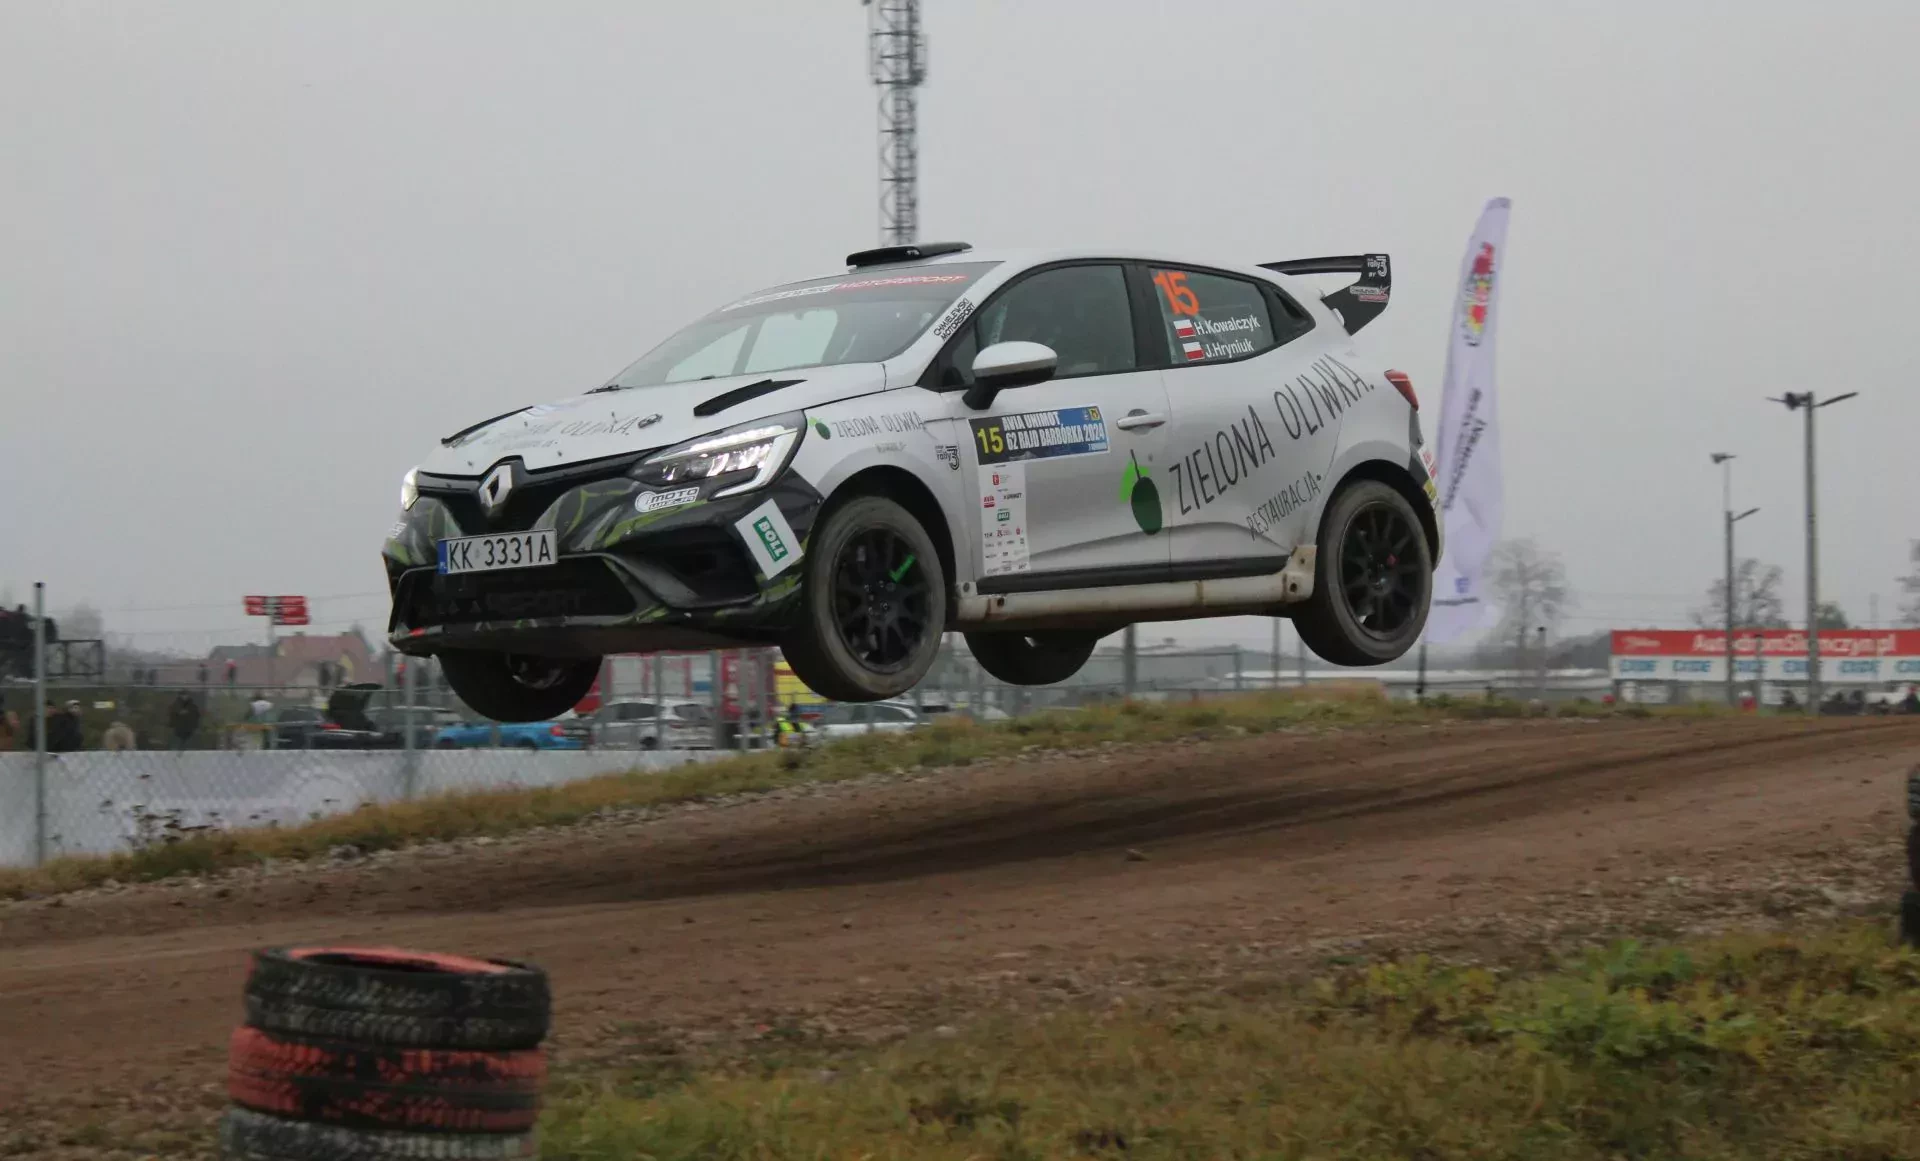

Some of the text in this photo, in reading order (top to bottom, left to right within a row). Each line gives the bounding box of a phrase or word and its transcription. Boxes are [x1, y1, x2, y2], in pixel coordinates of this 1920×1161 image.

[1153, 271, 1199, 316] 15
[933, 298, 969, 337] CHMIELEWSKI
[941, 303, 975, 341] MOTORSPORT
[1194, 314, 1261, 335] H.Kowalczyk
[1205, 338, 1255, 359] J.Hryniuk
[831, 415, 881, 438] ZIELONA
[1002, 411, 1060, 431] AVIA UNIMOT
[977, 426, 1004, 454] 15
[1005, 422, 1105, 451] 62 RAJD BARBÓRKA 2024
[1168, 404, 1275, 516] ZIELONA
[650, 488, 698, 503] MOTO
[449, 533, 551, 570] KK 3331A
[757, 519, 787, 558] BOLL
